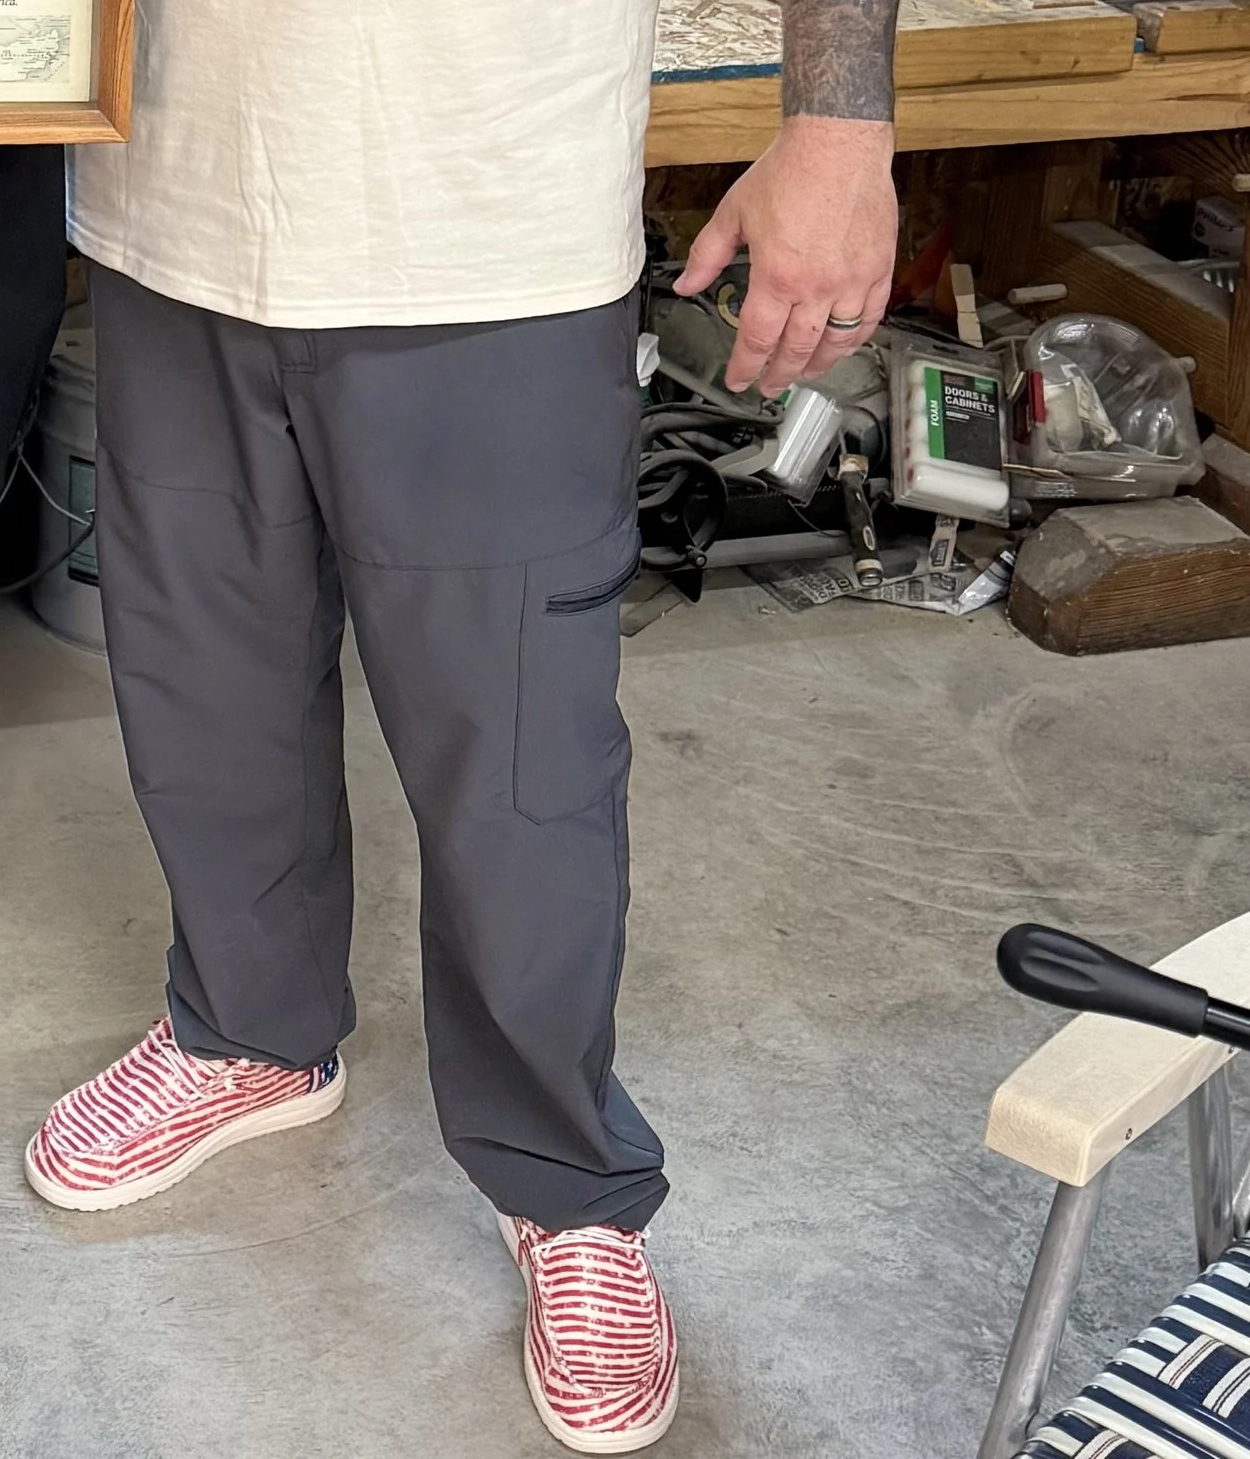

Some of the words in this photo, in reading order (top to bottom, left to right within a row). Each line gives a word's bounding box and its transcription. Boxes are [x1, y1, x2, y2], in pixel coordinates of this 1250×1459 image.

[944, 385, 980, 401] DOORS
[981, 393, 988, 402] &
[929, 399, 940, 427] FOAM
[944, 395, 996, 414] CABINETS
